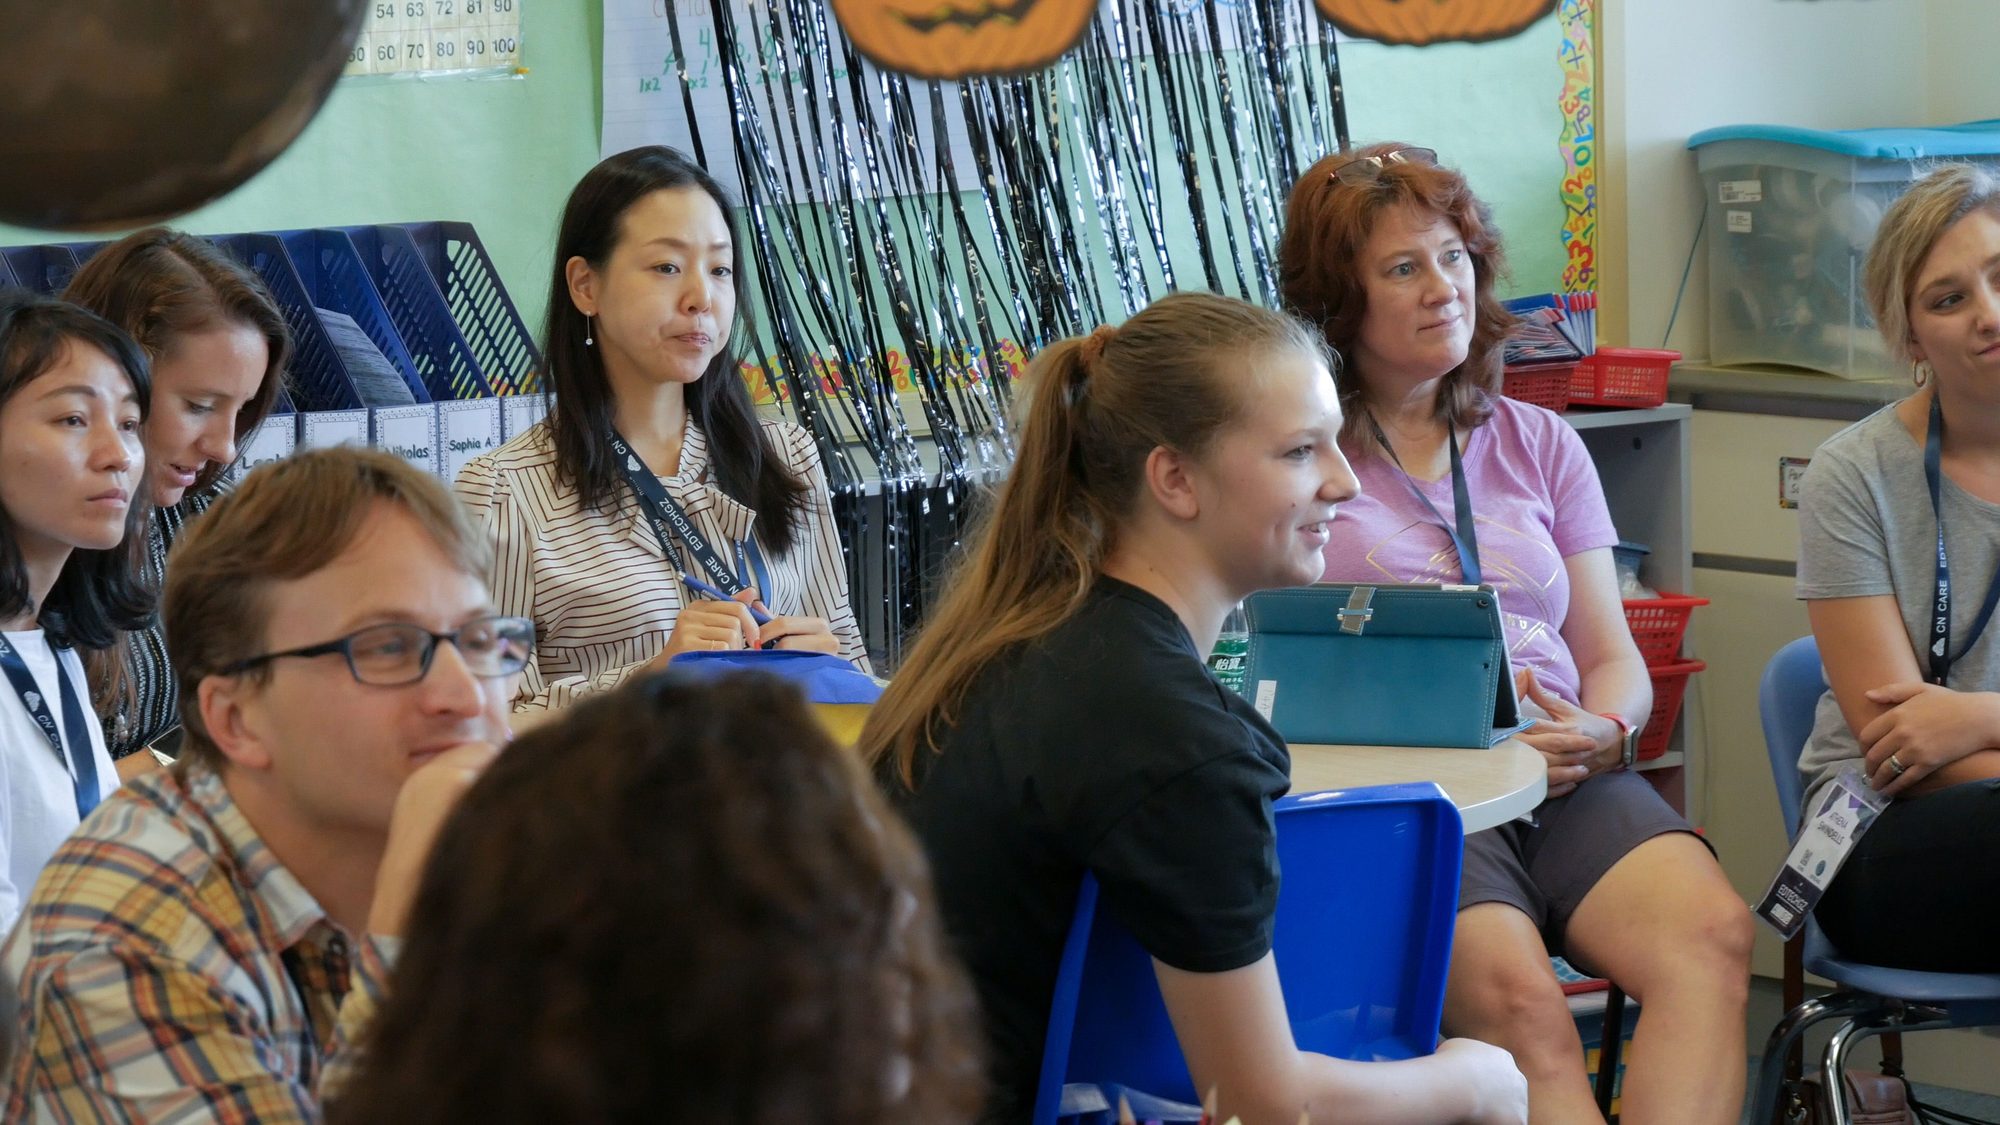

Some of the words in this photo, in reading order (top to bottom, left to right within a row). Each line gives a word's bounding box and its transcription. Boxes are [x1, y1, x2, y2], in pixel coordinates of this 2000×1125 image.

[376, 4, 394, 18] 54
[406, 2, 424, 17] 63
[436, 1, 453, 15] 72
[467, 0, 482, 14] 81
[494, 0, 511, 12] 90
[378, 45, 395, 60] 60
[407, 44, 424, 58] 70
[437, 42, 454, 57] 80
[467, 40, 484, 55] 90
[492, 38, 515, 53] 100
[449, 437, 481, 454] Sophia
[485, 436, 493, 449] A
[612, 440, 627, 455] CN
[659, 498, 703, 552] EDTECHGZ
[705, 556, 731, 584] CARE
[1938, 580, 1948, 612] CARE
[1936, 616, 1947, 633] CN
